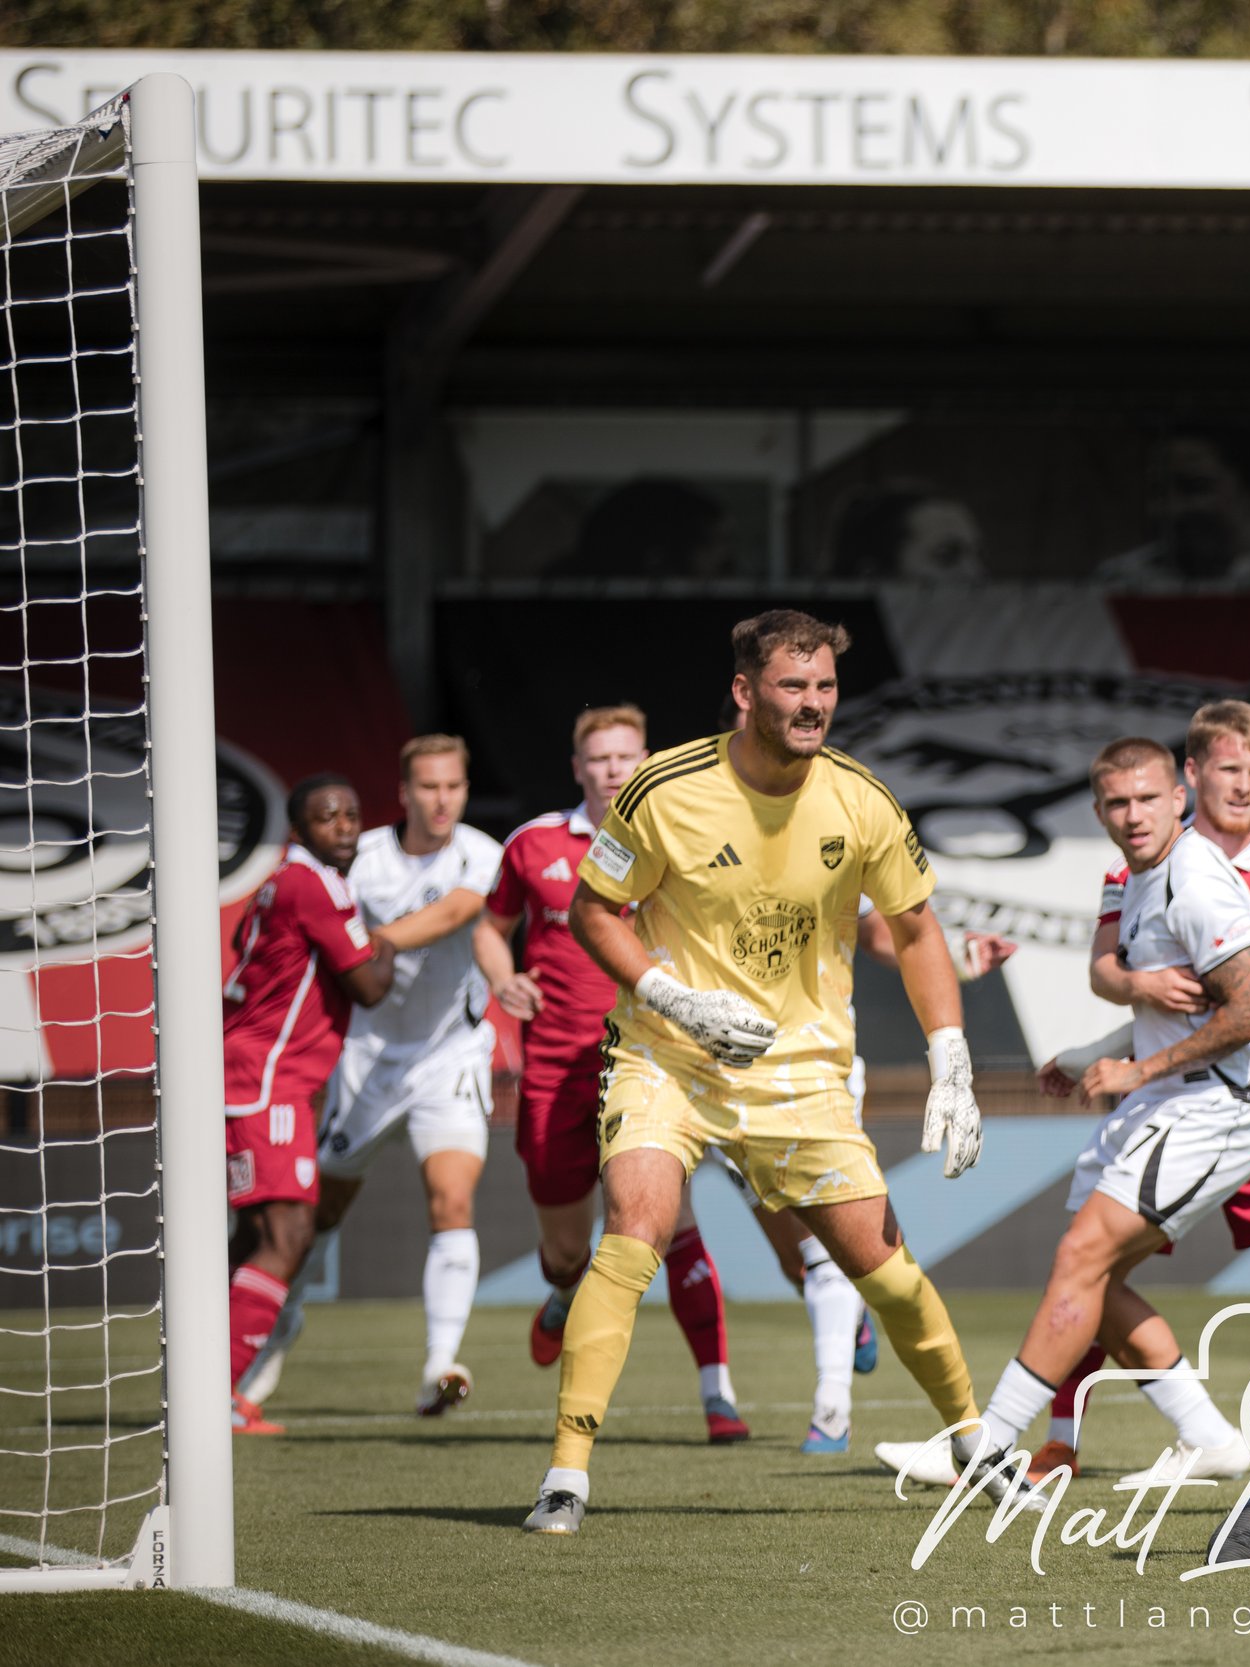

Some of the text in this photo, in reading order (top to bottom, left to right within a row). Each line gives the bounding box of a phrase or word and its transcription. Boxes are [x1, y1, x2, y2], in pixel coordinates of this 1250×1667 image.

[14, 62, 1032, 172] SURITEC SYSTEMS
[1124, 1124, 1160, 1160] 7
[152, 1530, 165, 1589] FORZA
